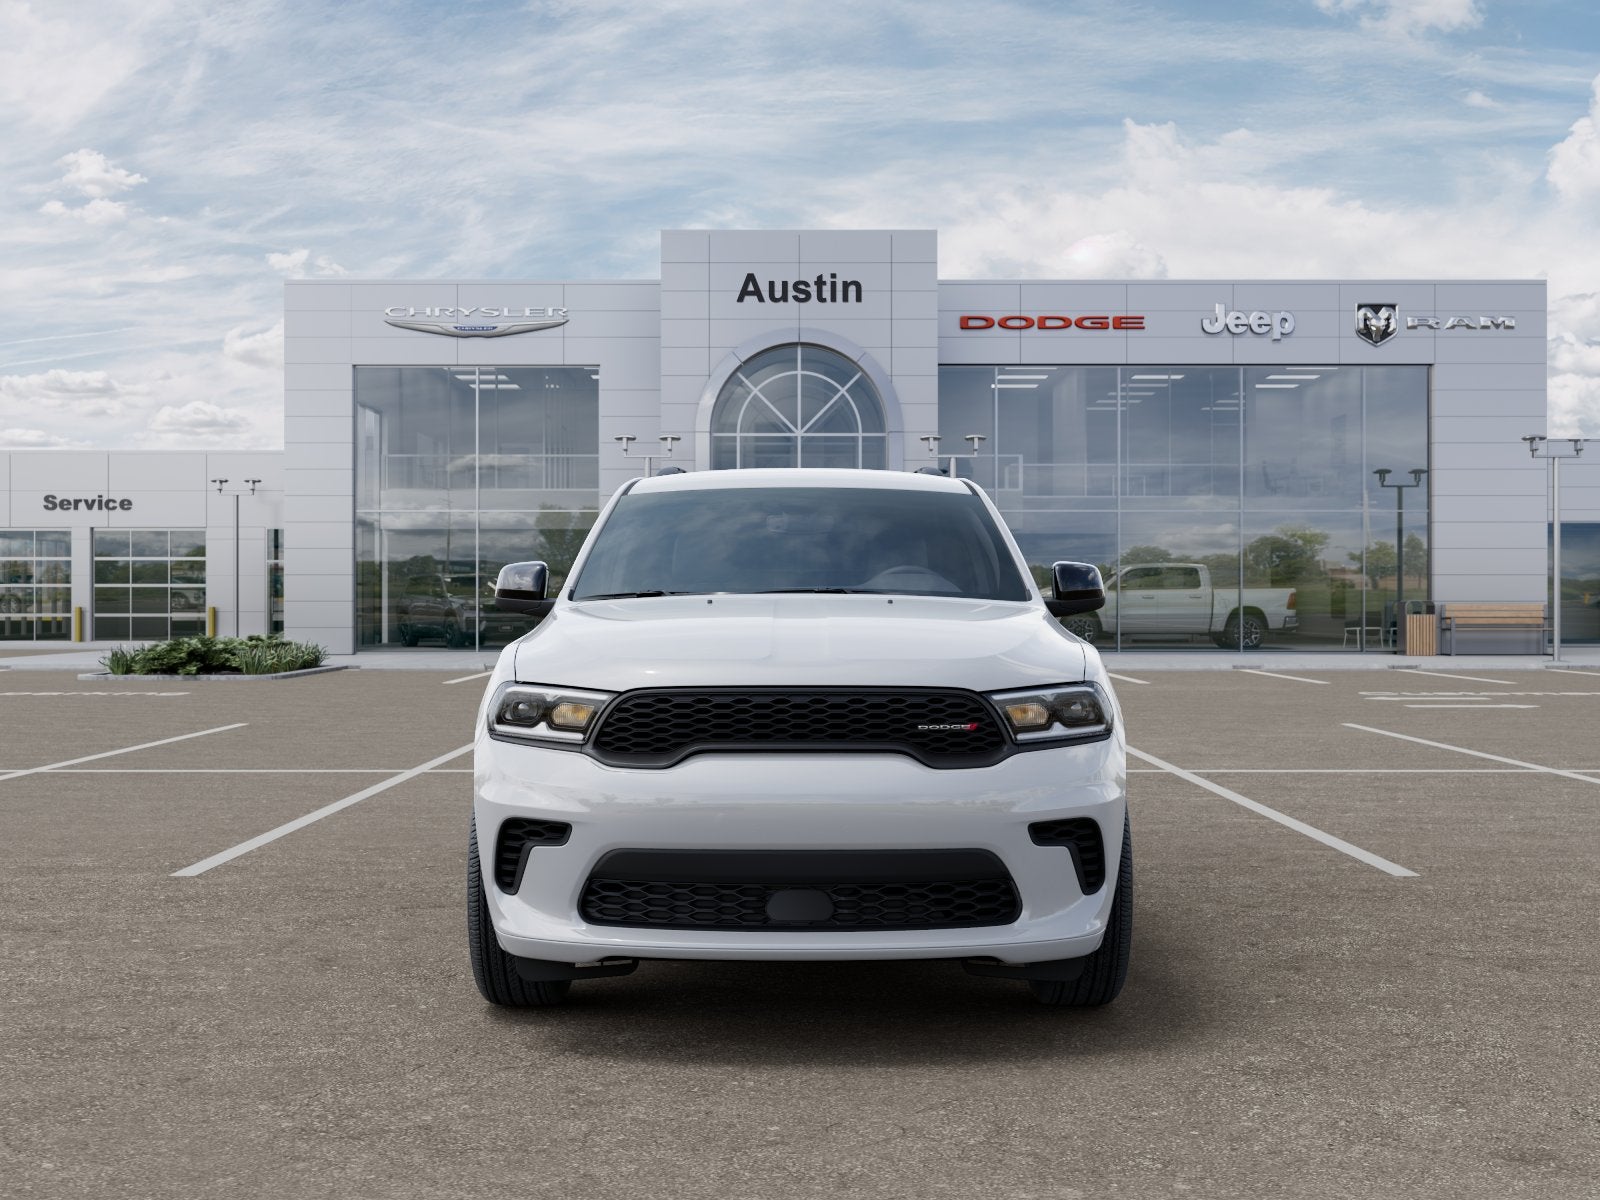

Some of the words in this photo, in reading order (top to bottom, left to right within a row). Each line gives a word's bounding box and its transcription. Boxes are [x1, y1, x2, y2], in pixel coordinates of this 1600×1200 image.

[736, 273, 863, 303] Austin
[384, 306, 569, 317] CHRYSLER
[959, 315, 1146, 330] DODGE
[1201, 303, 1295, 341] Jeep
[1406, 316, 1516, 330] RAM
[43, 494, 133, 511] Service
